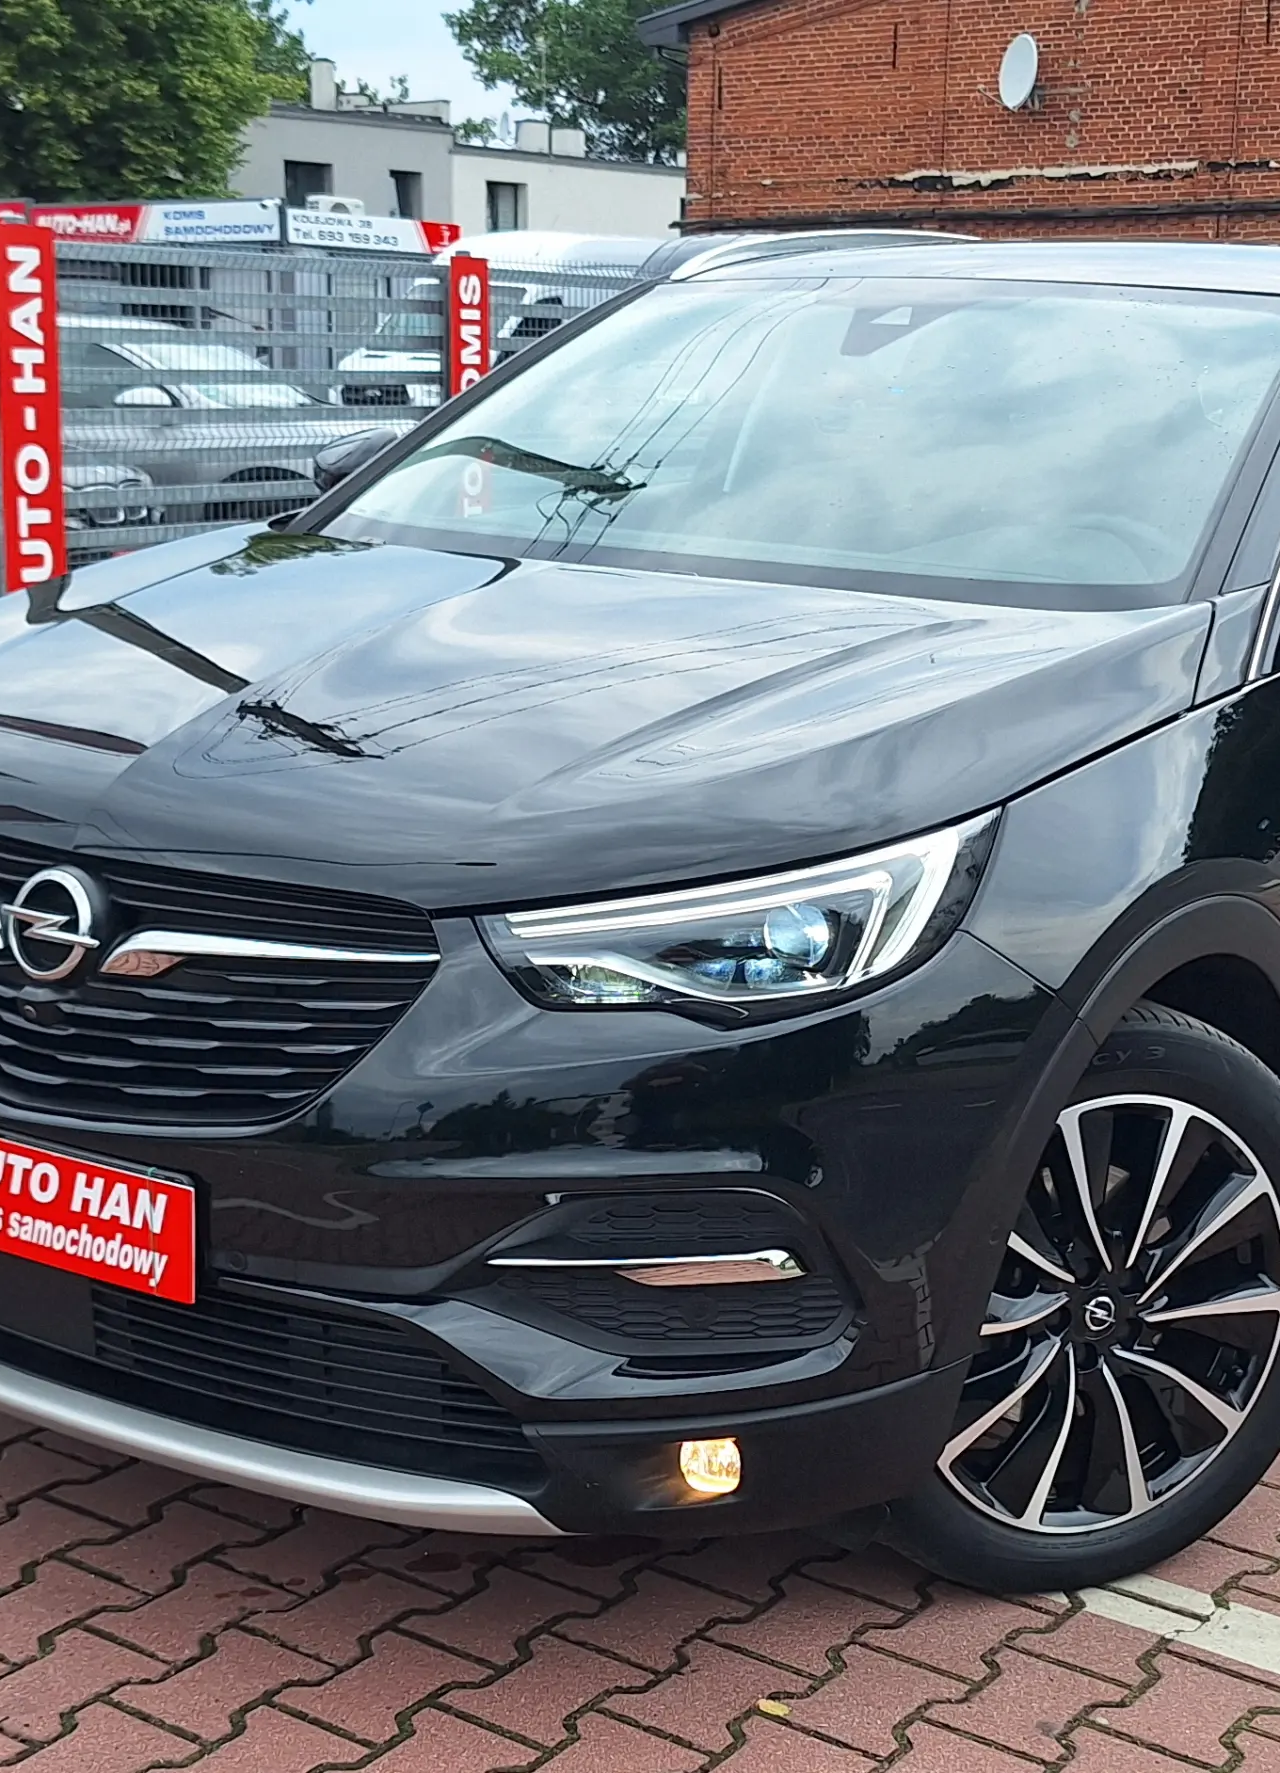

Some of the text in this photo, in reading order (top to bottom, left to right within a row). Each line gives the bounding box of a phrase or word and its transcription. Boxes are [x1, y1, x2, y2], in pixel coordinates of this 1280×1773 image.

[162, 210, 205, 221] KOMIS
[164, 223, 275, 236] SAMOCHODOWY
[318, 229, 344, 242] 693
[348, 232, 370, 244] 159
[373, 234, 399, 247] 343
[458, 273, 483, 519] TO OMIS
[15, 444, 54, 583] UTO
[70, 1172, 169, 1235] HAN
[6, 1211, 169, 1288] samochodowy
